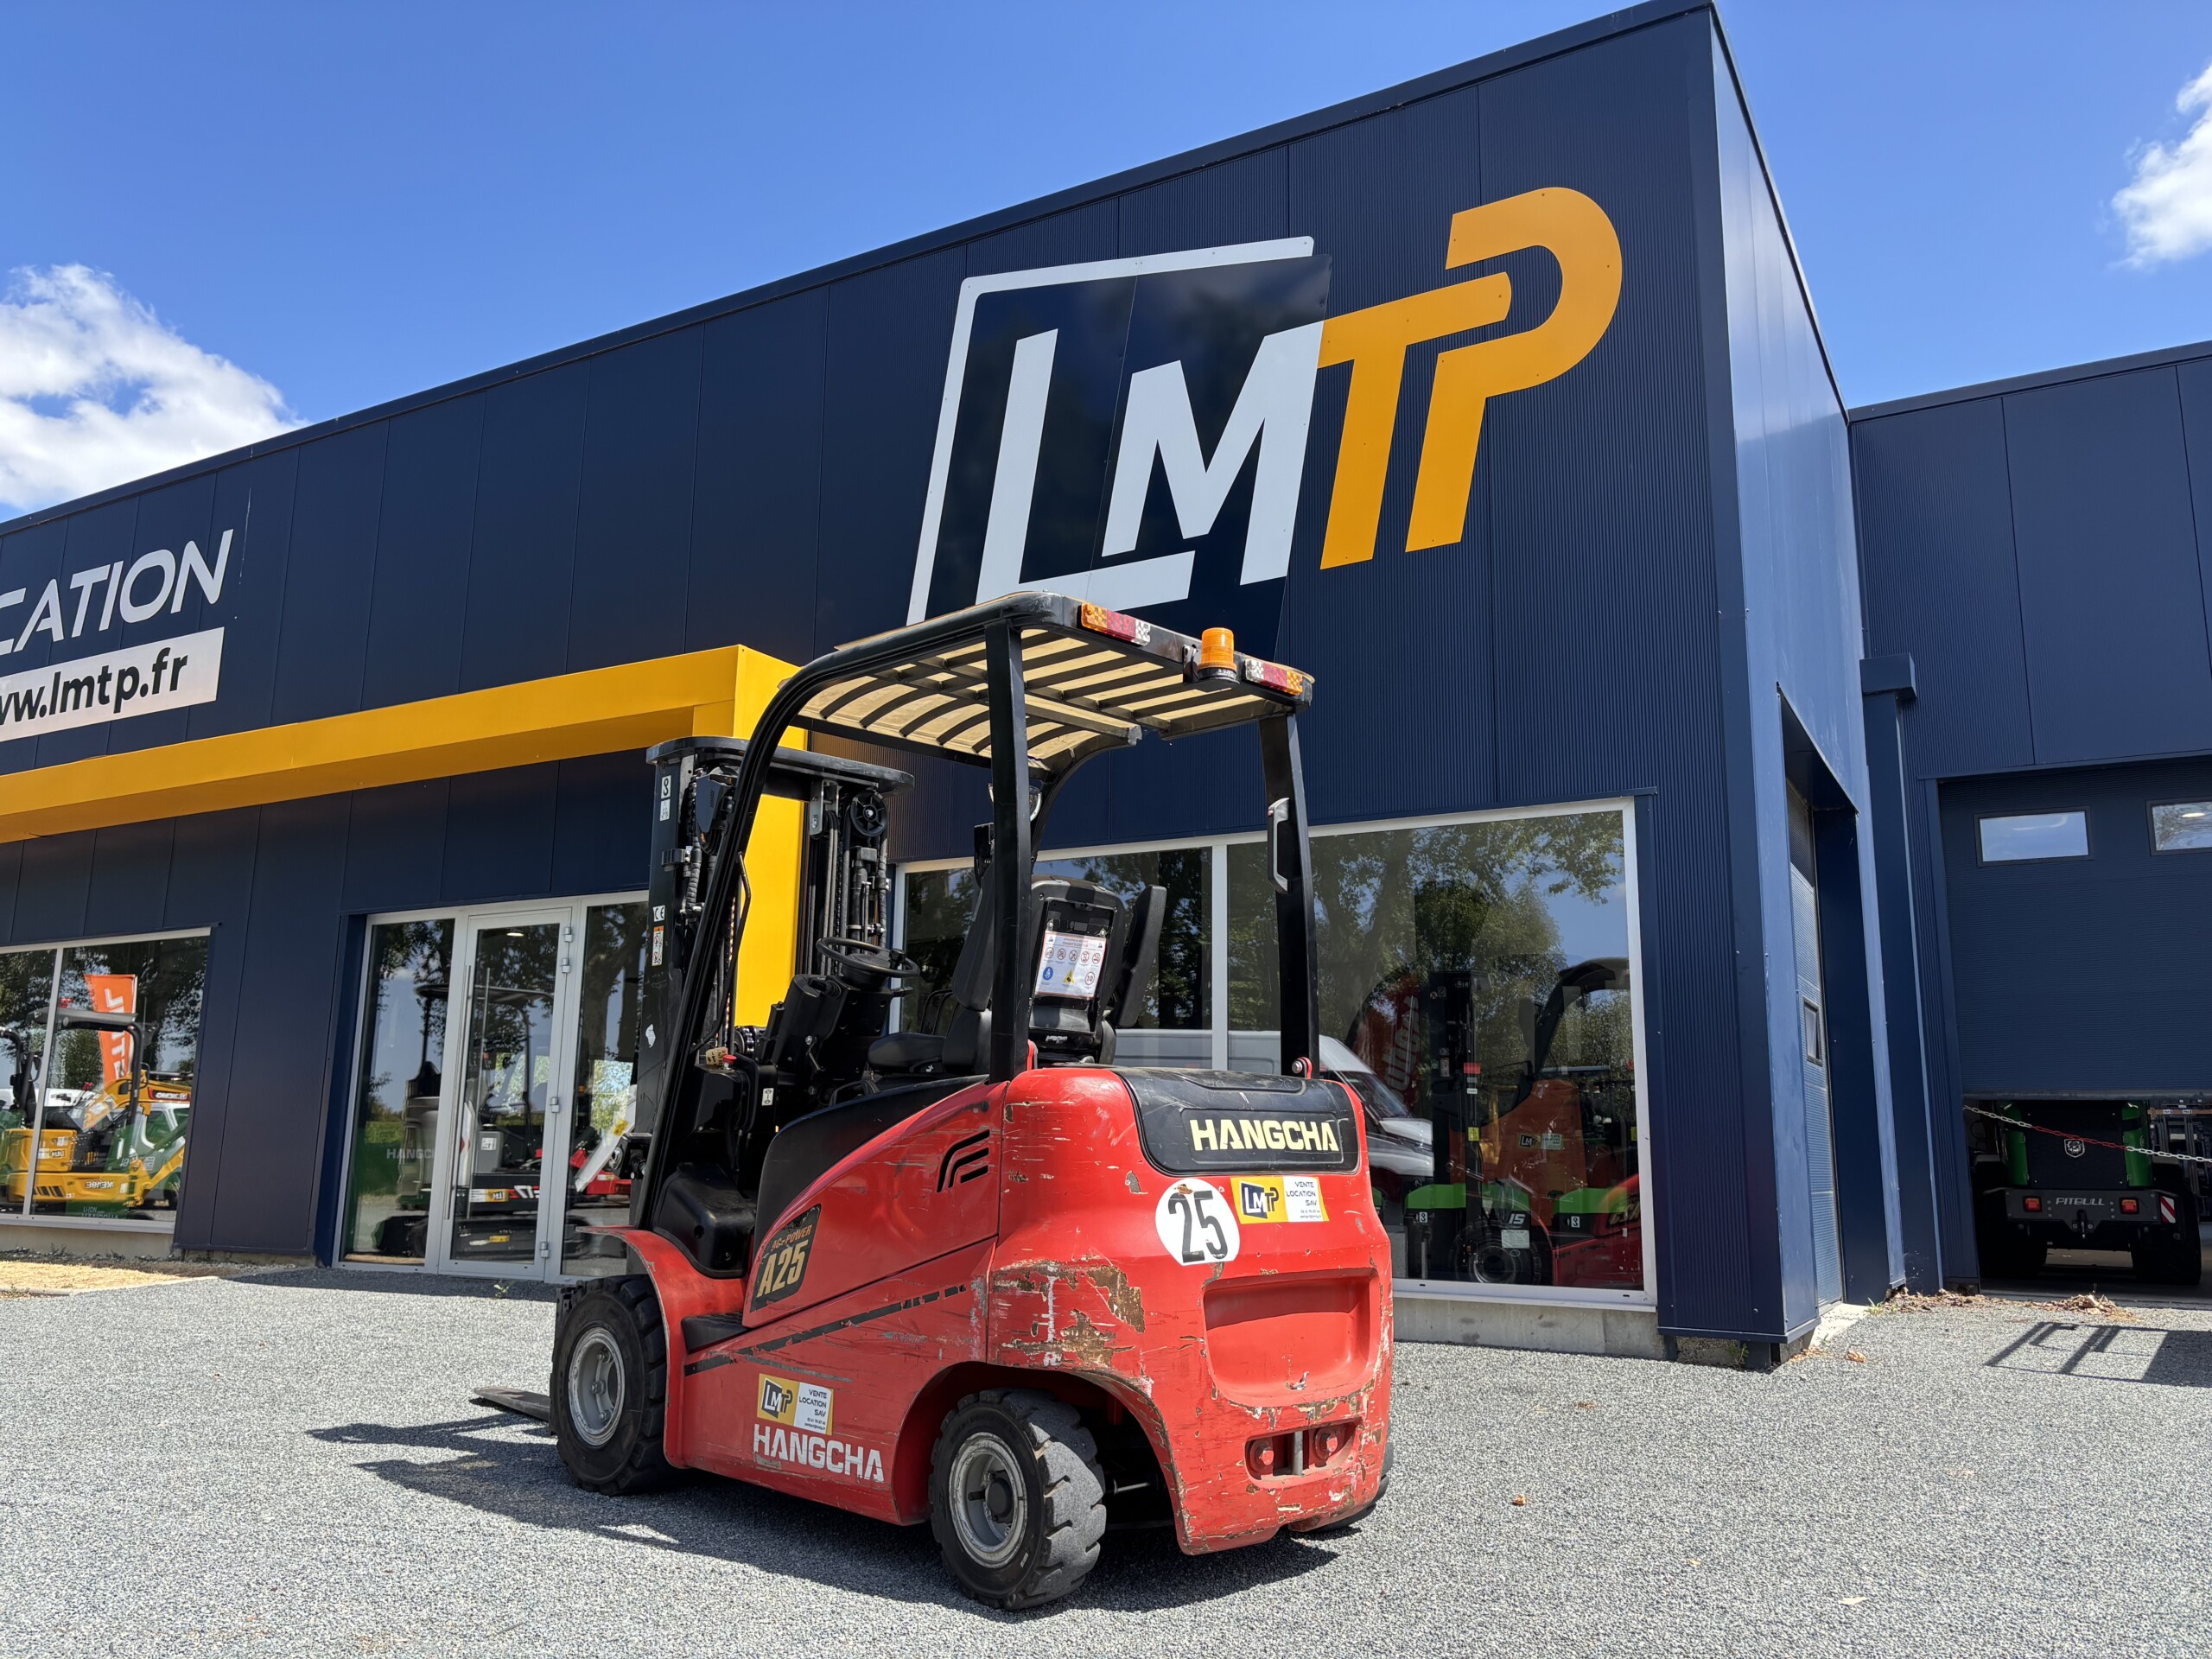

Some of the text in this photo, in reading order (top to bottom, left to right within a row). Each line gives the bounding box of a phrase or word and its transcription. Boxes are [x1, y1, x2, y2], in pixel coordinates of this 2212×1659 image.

[976, 187, 1623, 611] LMTP
[1189, 1119, 1339, 1152] HANGCHA
[386, 1148, 435, 1160] HANGC
[1244, 1185, 1280, 1214] LMTP
[2056, 1197, 2105, 1206] PITBULL
[1167, 1189, 1229, 1263] 25
[1509, 1213, 1526, 1224] 15
[756, 1239, 809, 1298] A25
[764, 1384, 793, 1414] LMTP
[798, 1395, 827, 1408] LOCATION
[808, 1389, 827, 1399] VENTE
[814, 1408, 827, 1417] SAV
[753, 1423, 885, 1483] HANGCHA
